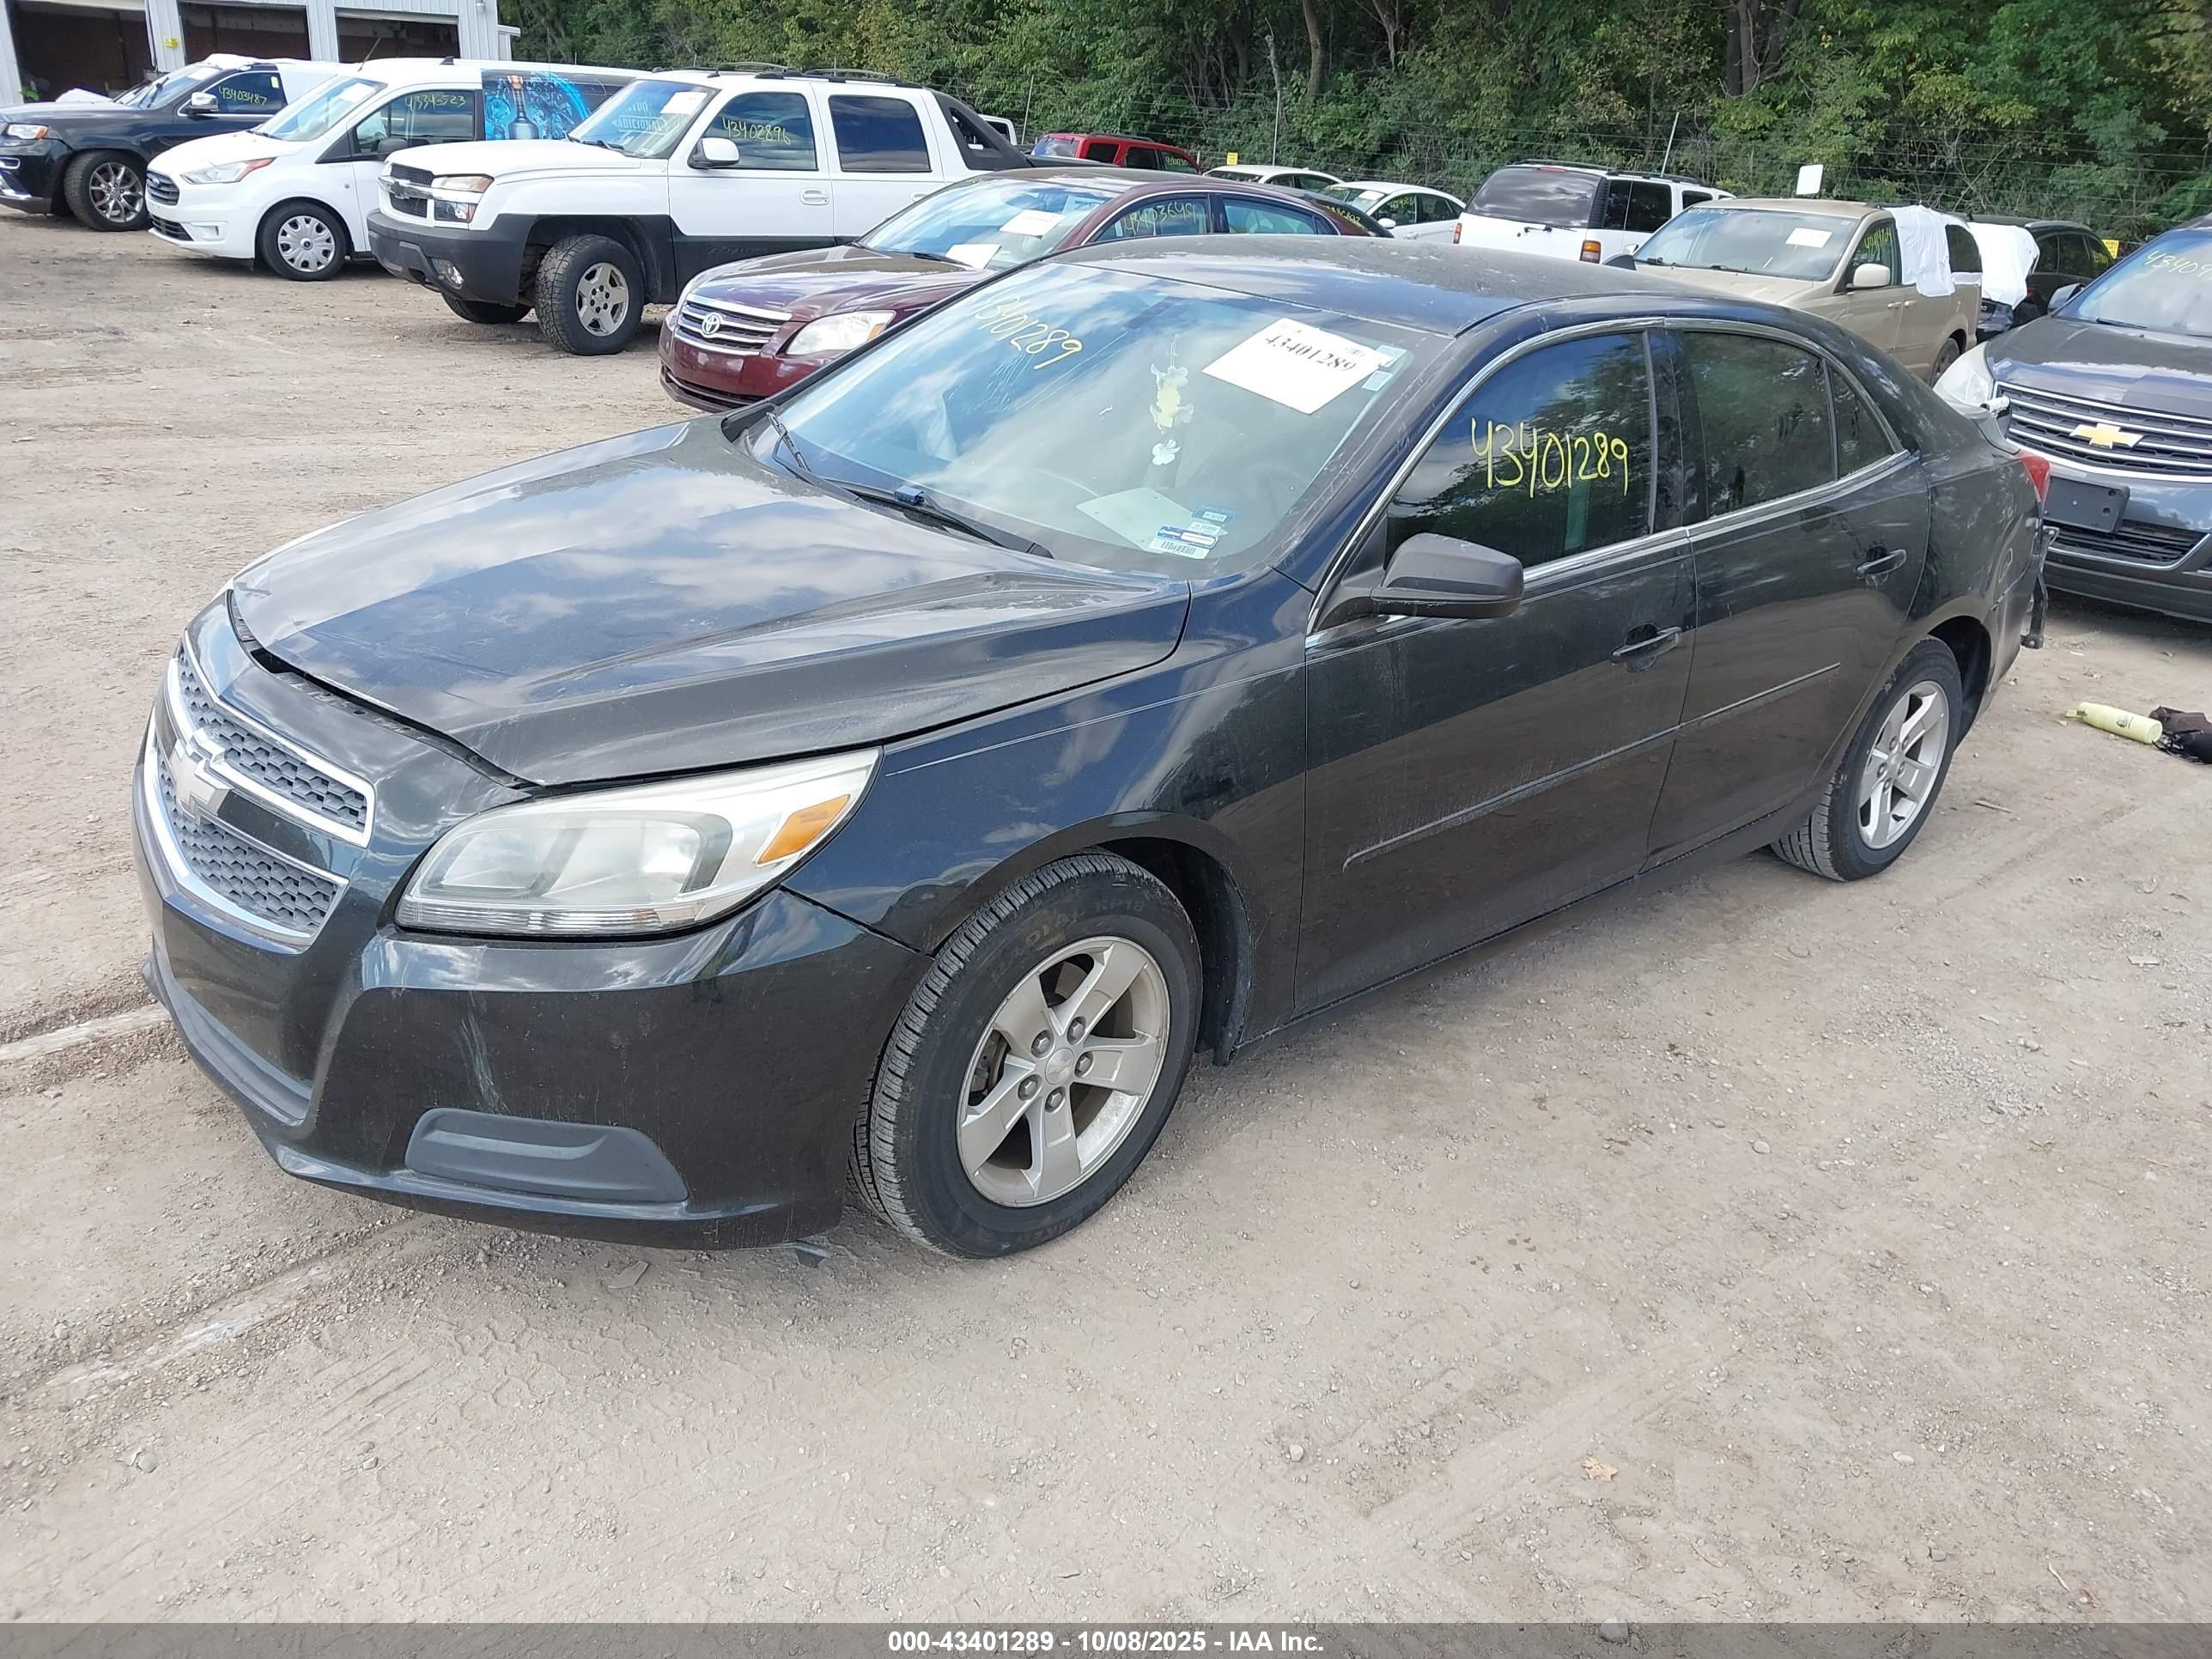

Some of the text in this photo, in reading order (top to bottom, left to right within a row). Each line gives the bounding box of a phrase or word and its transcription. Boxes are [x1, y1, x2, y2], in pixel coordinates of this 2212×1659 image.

[722, 117, 790, 145] 43402896
[1265, 334, 1357, 371] 43401289
[1471, 416, 1628, 498] 43401289
